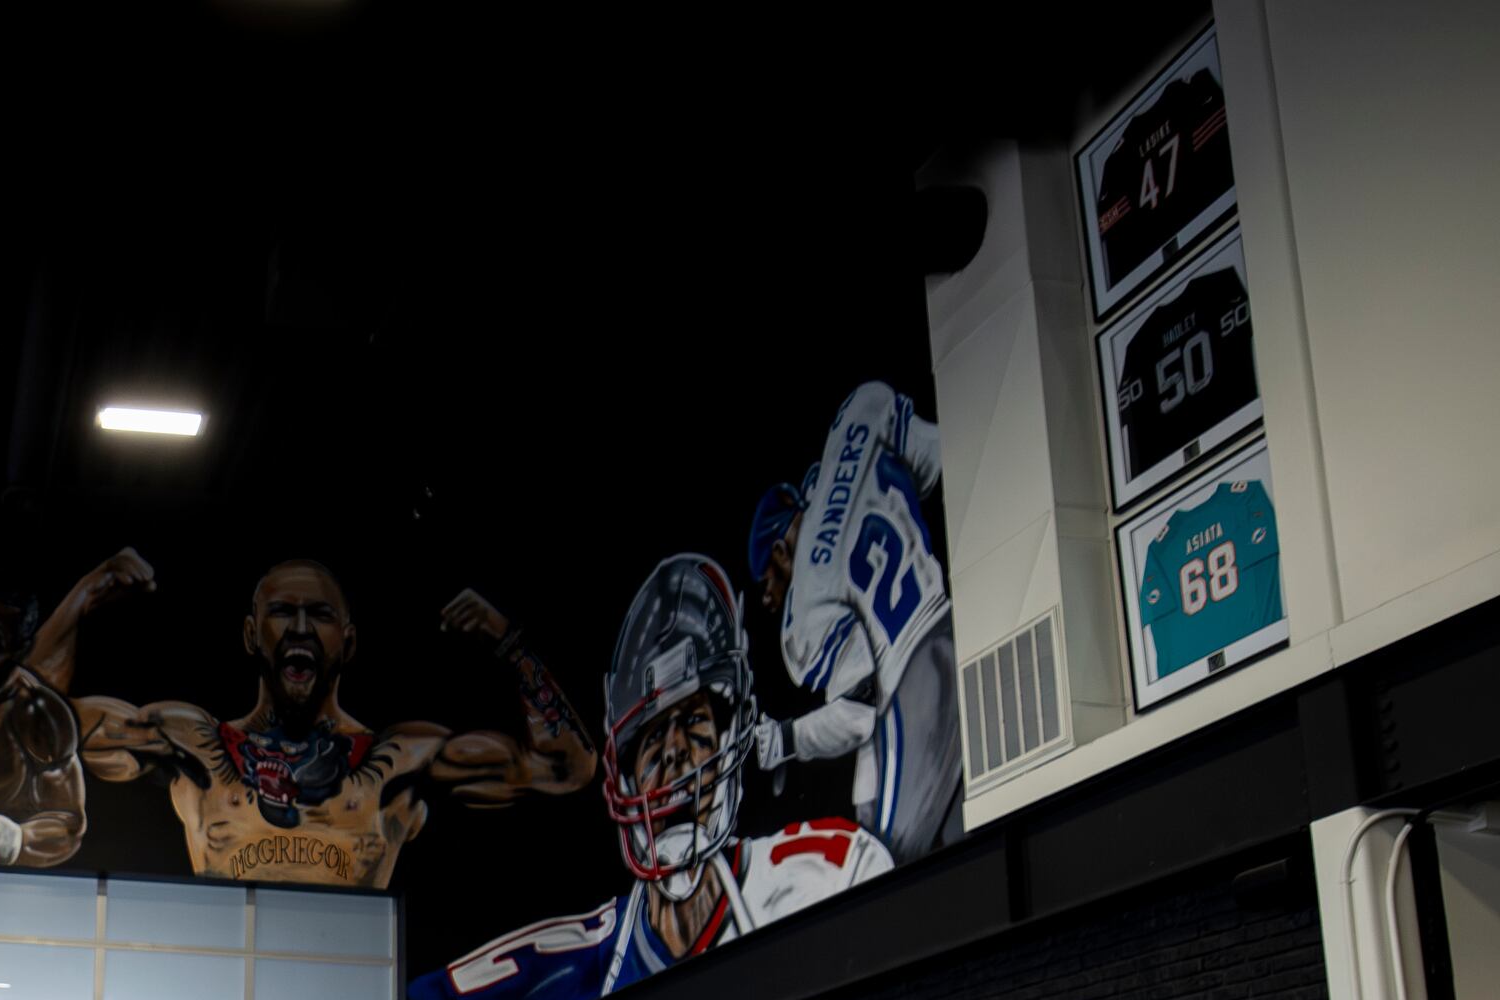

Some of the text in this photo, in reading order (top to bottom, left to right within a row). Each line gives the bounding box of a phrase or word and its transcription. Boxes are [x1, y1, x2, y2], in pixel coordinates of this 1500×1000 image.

[1139, 132, 1181, 210] 47
[1220, 301, 1251, 339] 50
[1155, 329, 1214, 415] 50
[811, 421, 869, 565] SANDERS
[1179, 539, 1239, 617] 68
[1186, 522, 1224, 556] ASIATA
